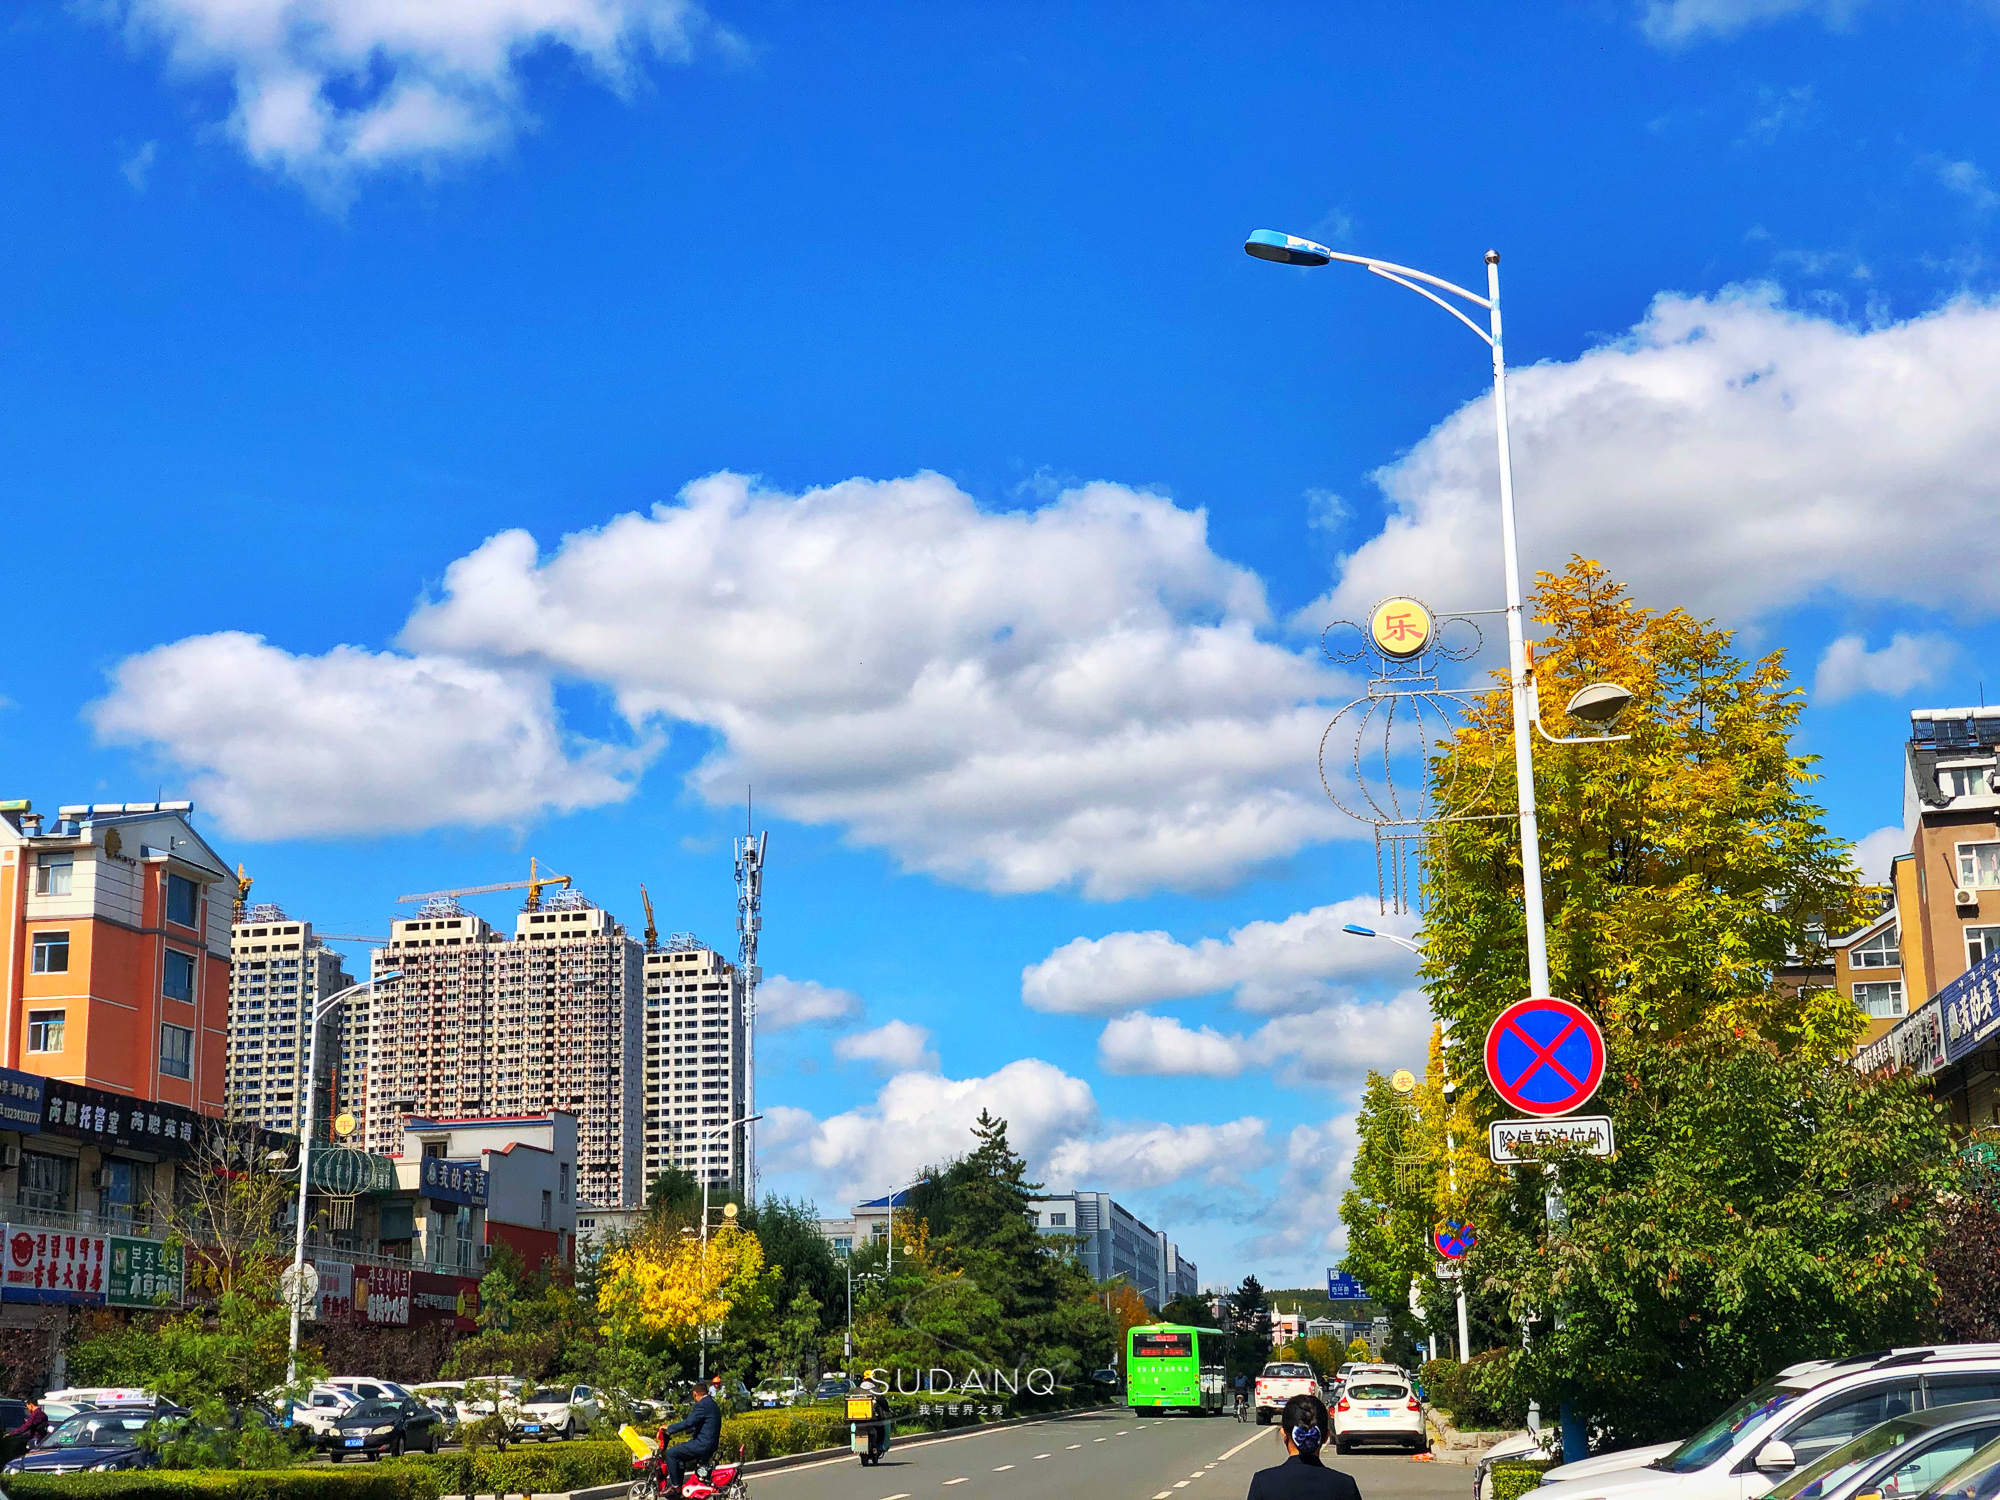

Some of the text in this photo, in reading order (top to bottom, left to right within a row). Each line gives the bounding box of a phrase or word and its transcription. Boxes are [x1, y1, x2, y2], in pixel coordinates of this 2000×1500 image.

[1382, 613, 1424, 641] 乐
[1396, 1076, 1412, 1087] 安
[337, 1120, 353, 1131] 平
[438, 1164, 485, 1195] 我的英语
